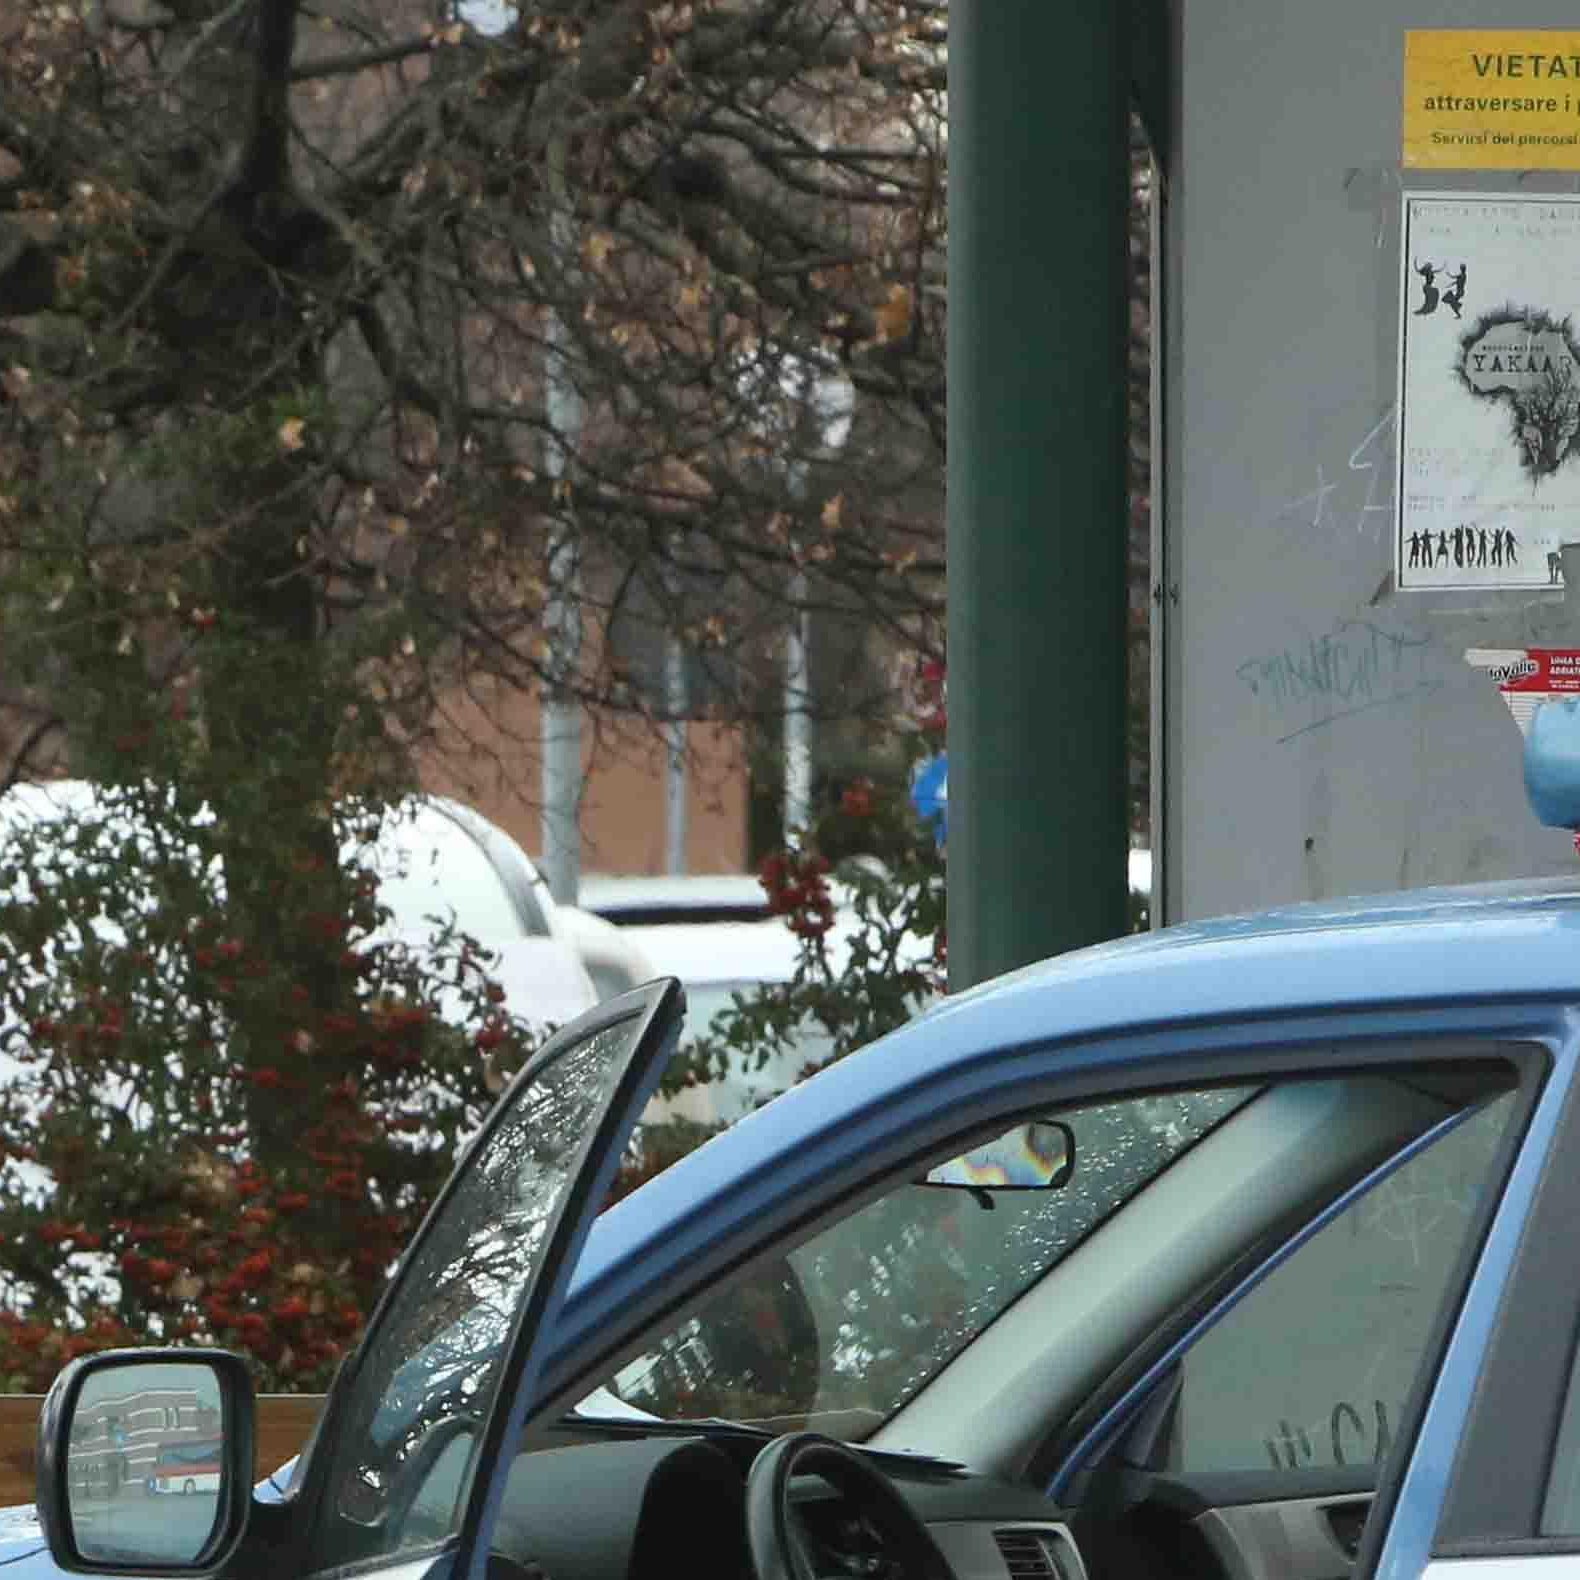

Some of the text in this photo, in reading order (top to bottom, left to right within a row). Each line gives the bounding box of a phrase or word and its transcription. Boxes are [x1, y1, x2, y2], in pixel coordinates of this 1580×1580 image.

[1423, 95, 1558, 113] attraversare
[1564, 94, 1570, 113] i
[1432, 131, 1488, 145] Servirsi
[1492, 132, 1515, 145] dei
[1518, 132, 1579, 147] percorsi
[1472, 353, 1573, 374] YAKAAR
